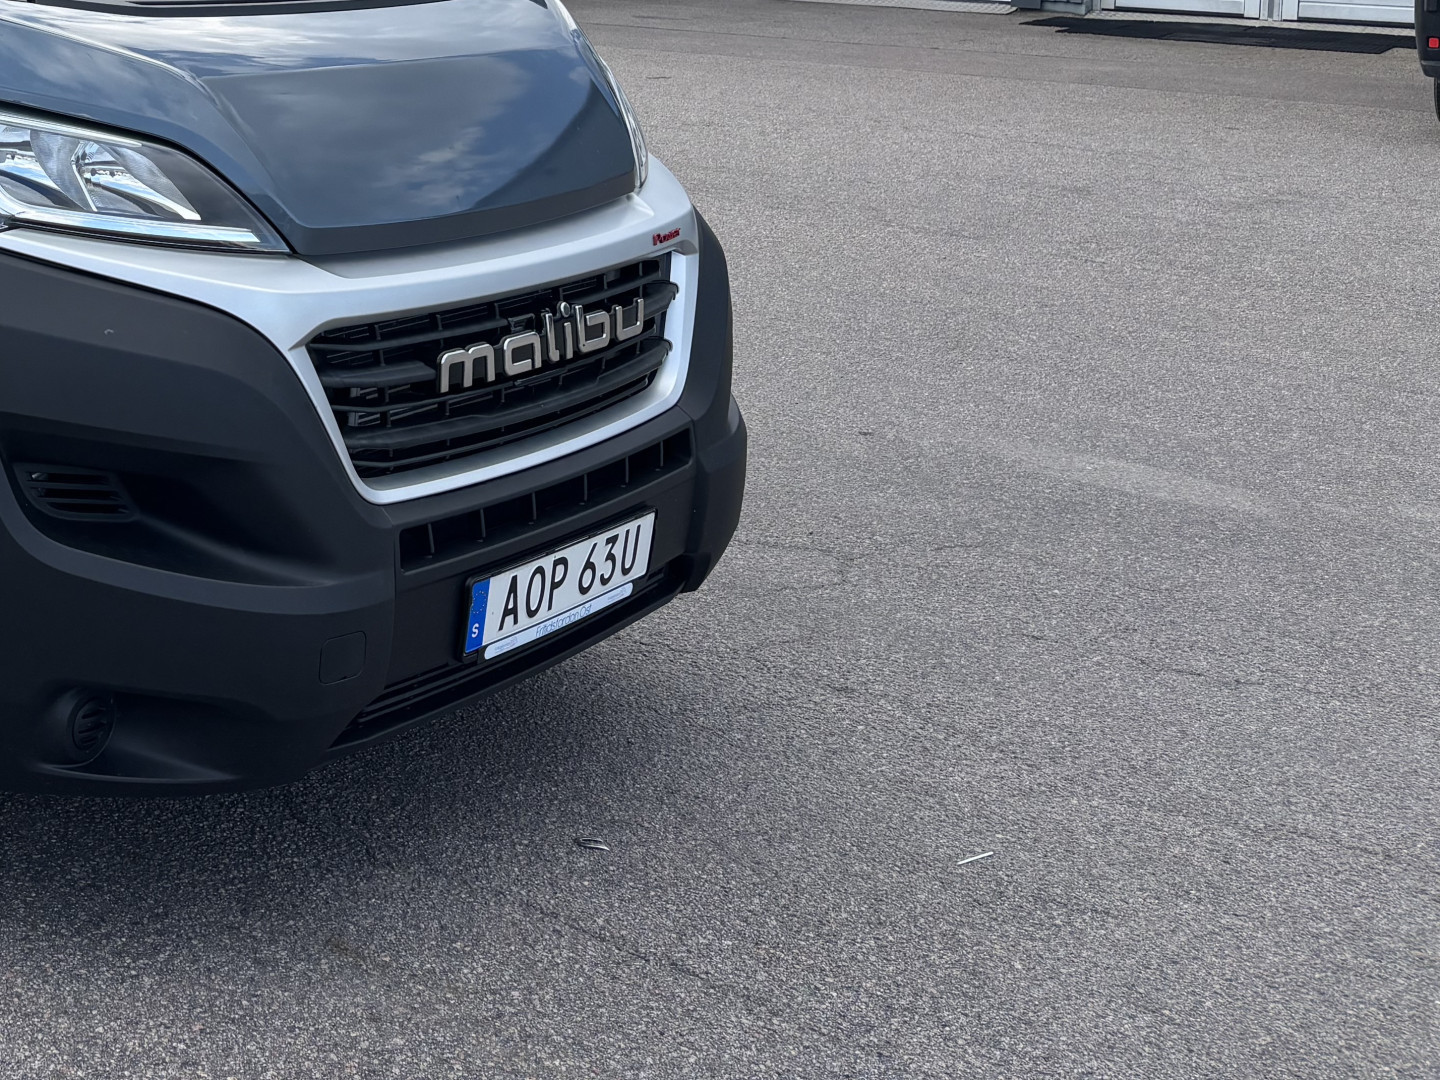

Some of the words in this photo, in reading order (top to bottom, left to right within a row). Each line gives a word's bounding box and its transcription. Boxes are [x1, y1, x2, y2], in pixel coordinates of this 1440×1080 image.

[440, 298, 644, 394] malibu
[498, 556, 569, 632] AOP
[578, 524, 642, 596] 63U
[471, 623, 479, 638] S
